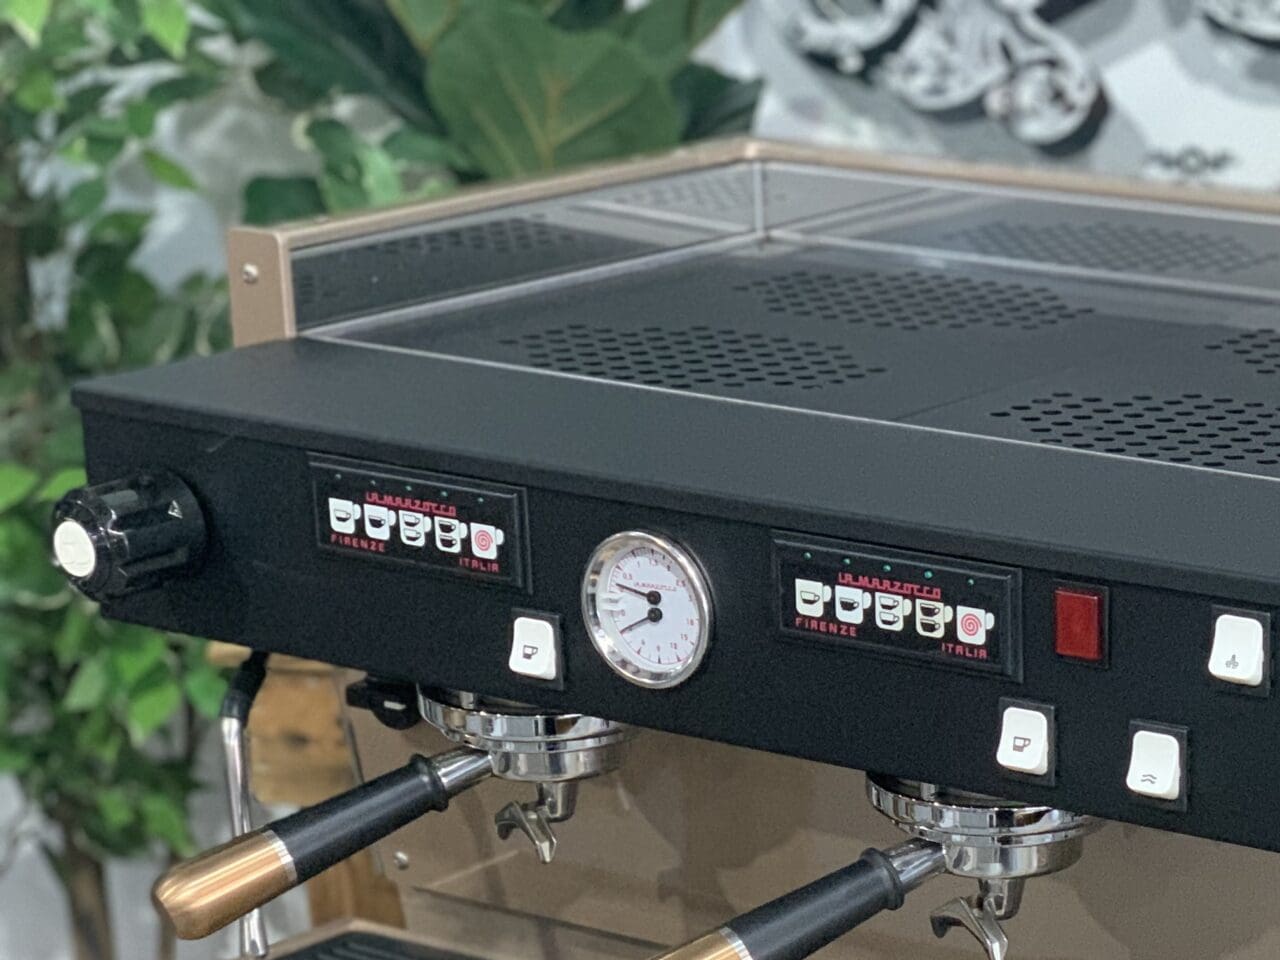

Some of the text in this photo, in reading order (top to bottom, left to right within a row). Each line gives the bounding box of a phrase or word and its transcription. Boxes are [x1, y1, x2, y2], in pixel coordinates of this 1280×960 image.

[331, 534, 386, 552] FIRENZE
[458, 558, 499, 573] ITALIA
[795, 617, 858, 636] FIRENZE
[941, 642, 988, 659] ITALIA
